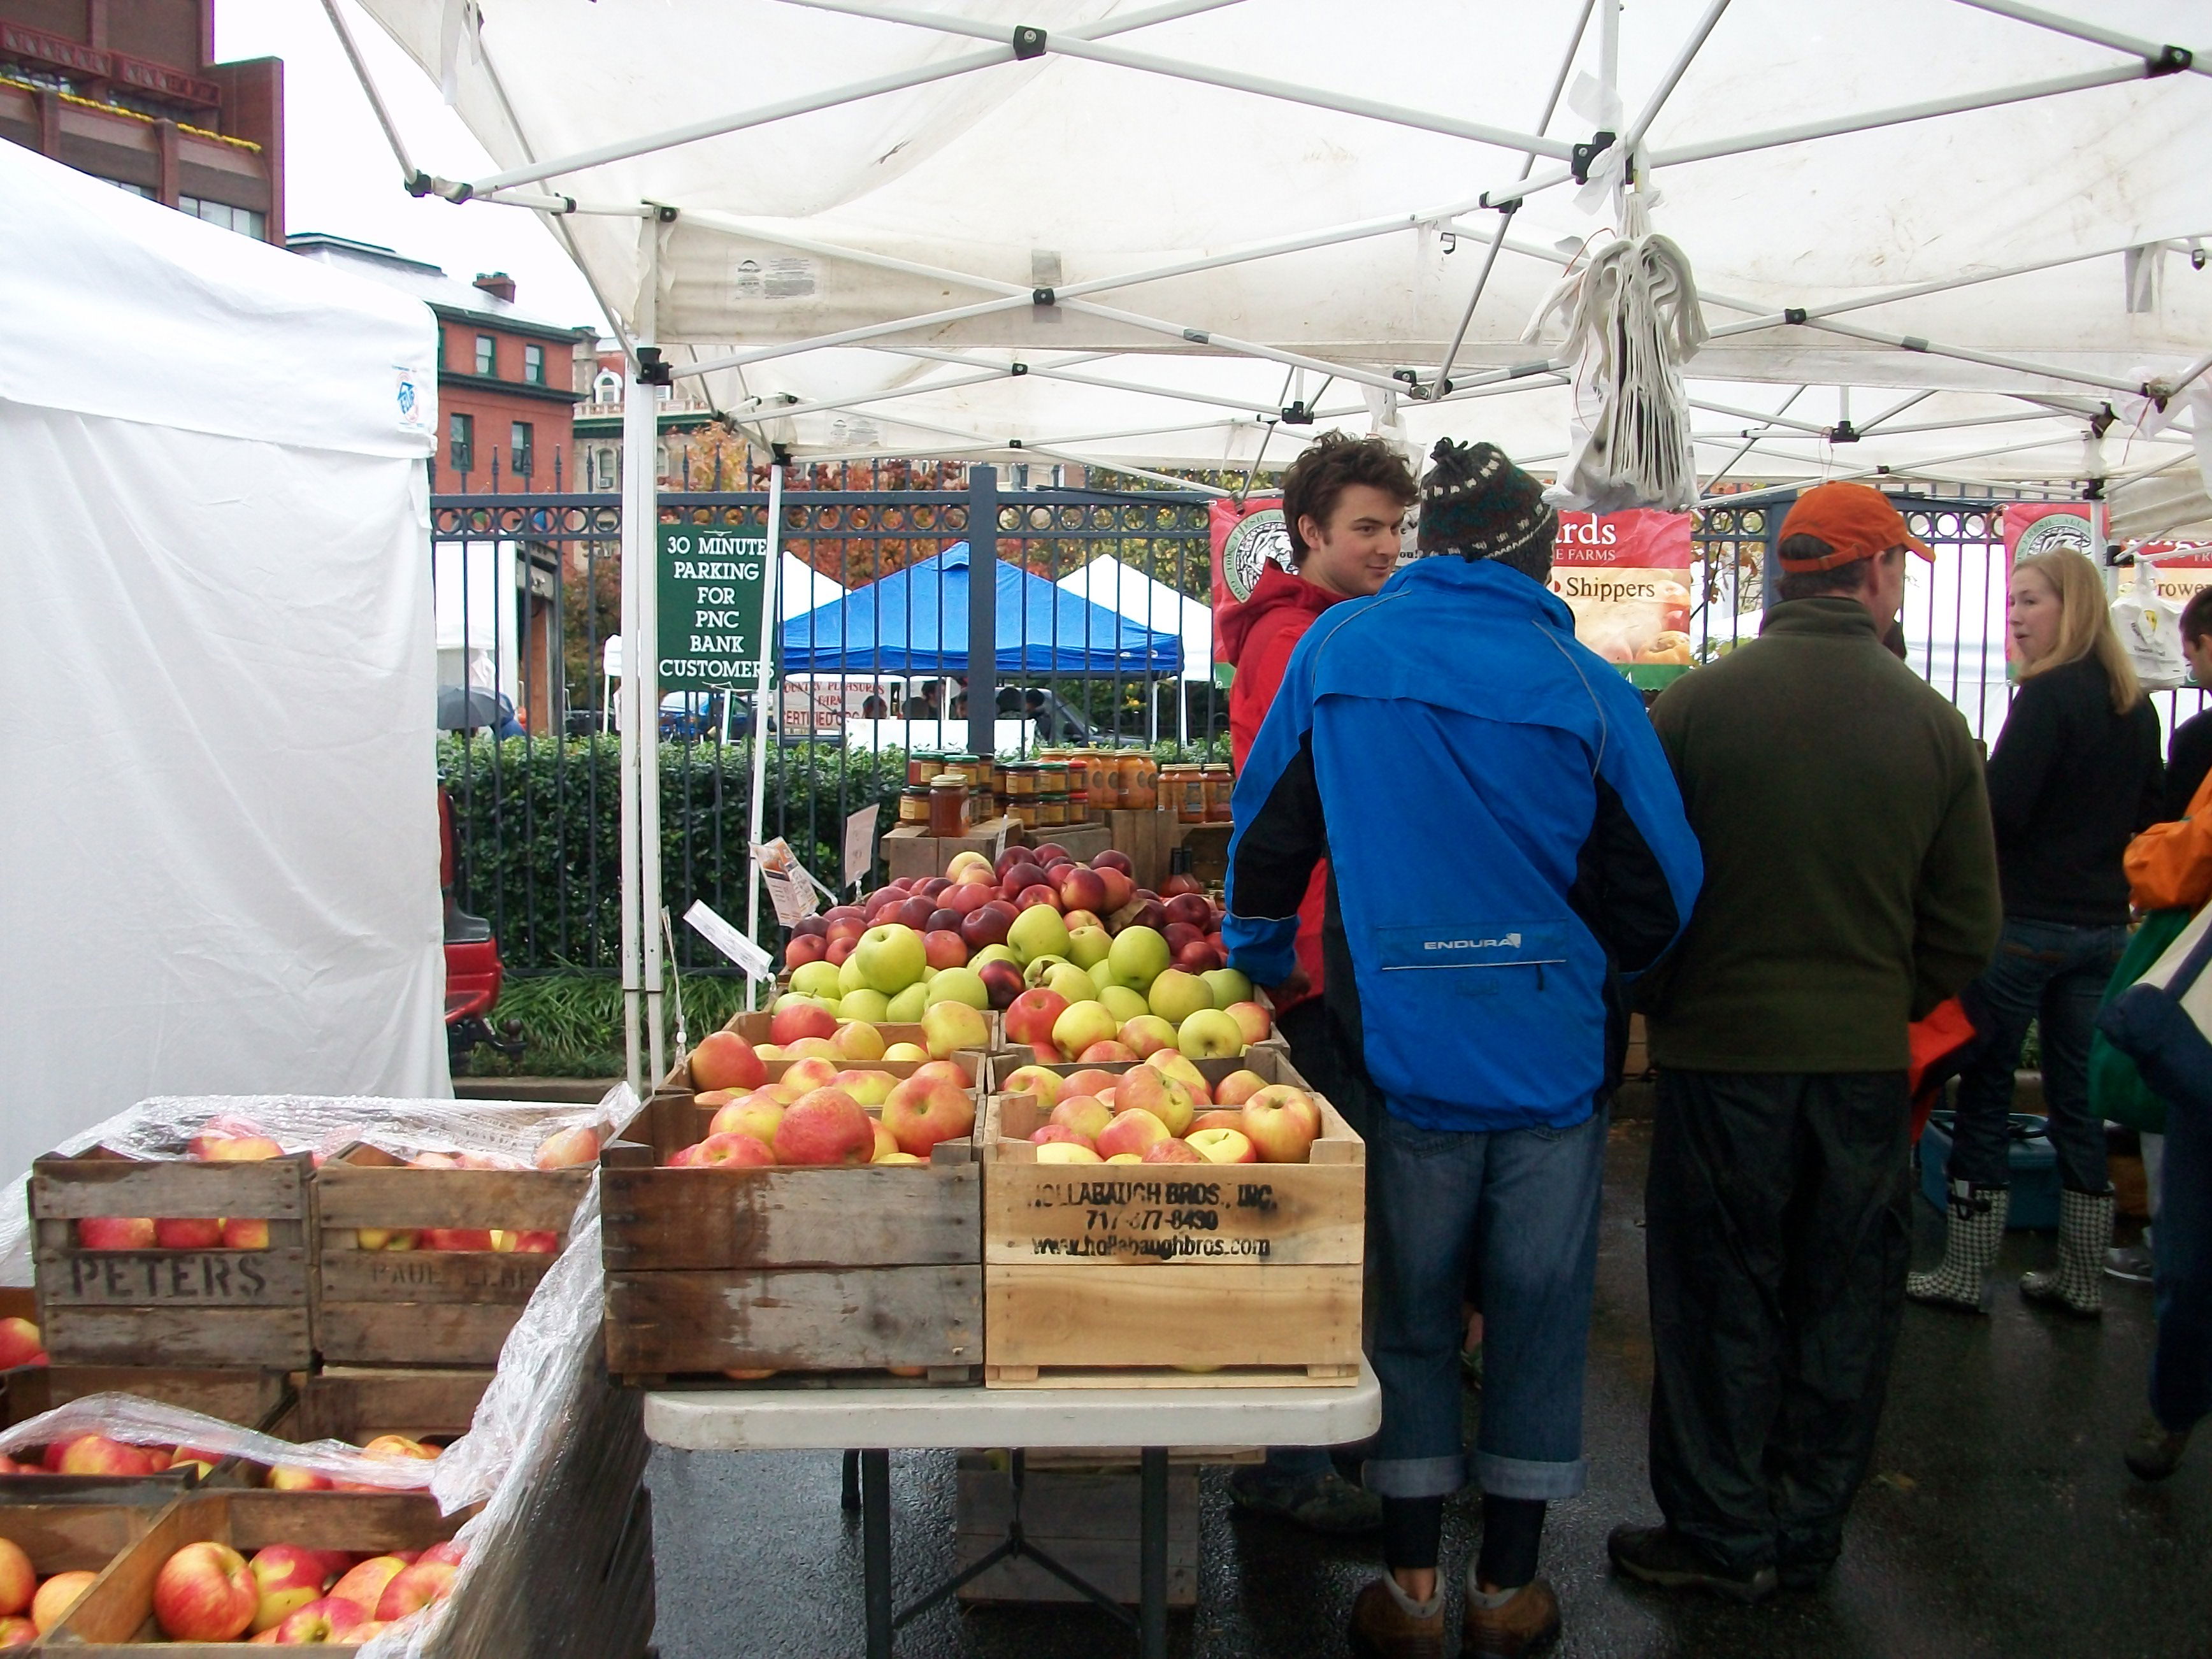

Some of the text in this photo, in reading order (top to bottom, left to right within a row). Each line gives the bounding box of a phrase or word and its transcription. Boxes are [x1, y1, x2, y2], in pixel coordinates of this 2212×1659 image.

[1555, 512, 1617, 545] rds
[667, 536, 766, 556] 30 MINUTE
[1568, 549, 1616, 561] FARMS
[673, 561, 759, 580] PARKING
[697, 587, 735, 605] FOR
[1566, 577, 1655, 602] Shippers
[2150, 578, 2212, 597] rowe
[695, 610, 740, 628] PNC
[690, 635, 745, 653] BANK
[784, 682, 884, 695] OUNTY PLASURS
[784, 710, 833, 726] ERTIIED
[1424, 938, 1512, 951] ENDURA
[71, 1256, 266, 1297] PETERS
